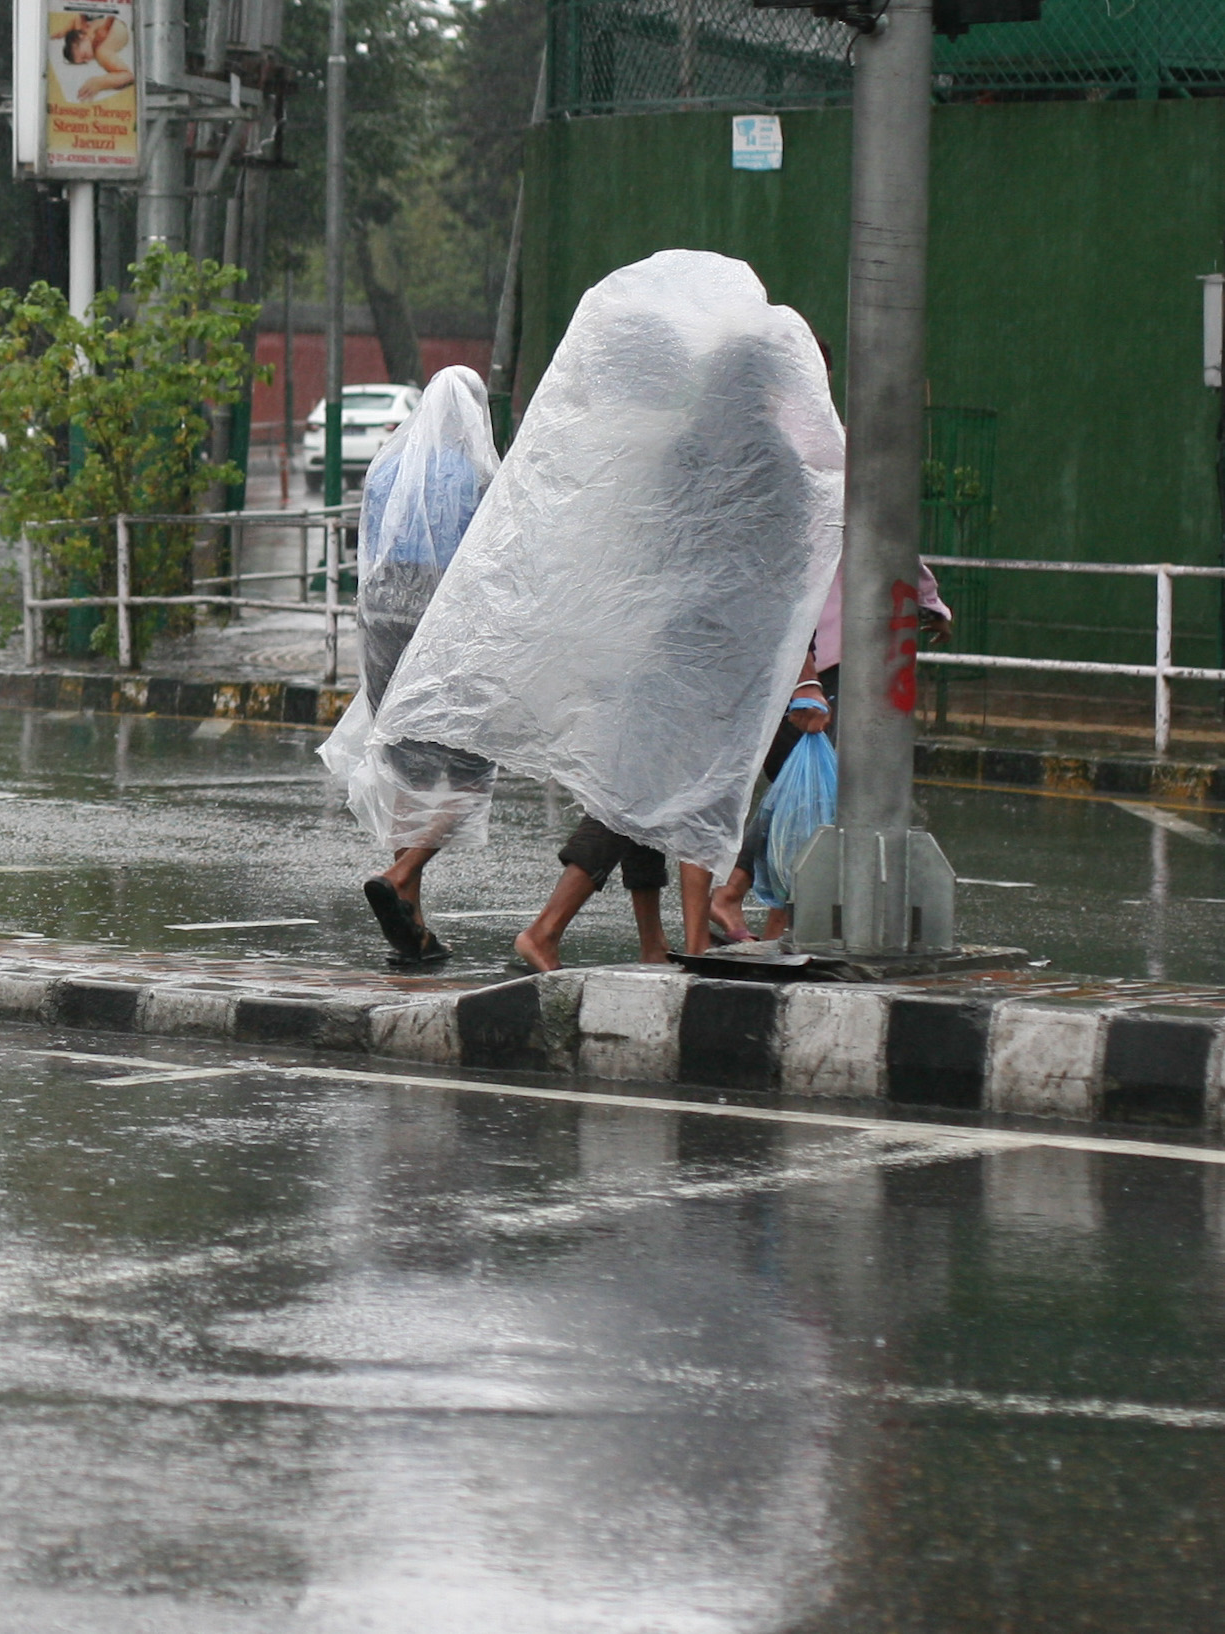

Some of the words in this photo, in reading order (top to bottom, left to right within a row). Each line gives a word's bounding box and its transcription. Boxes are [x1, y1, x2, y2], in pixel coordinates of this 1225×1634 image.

[93, 105, 133, 121] Therapy
[53, 119, 89, 133] Steam
[92, 121, 128, 136] Sauna
[72, 135, 115, 150] Jacuzzi
